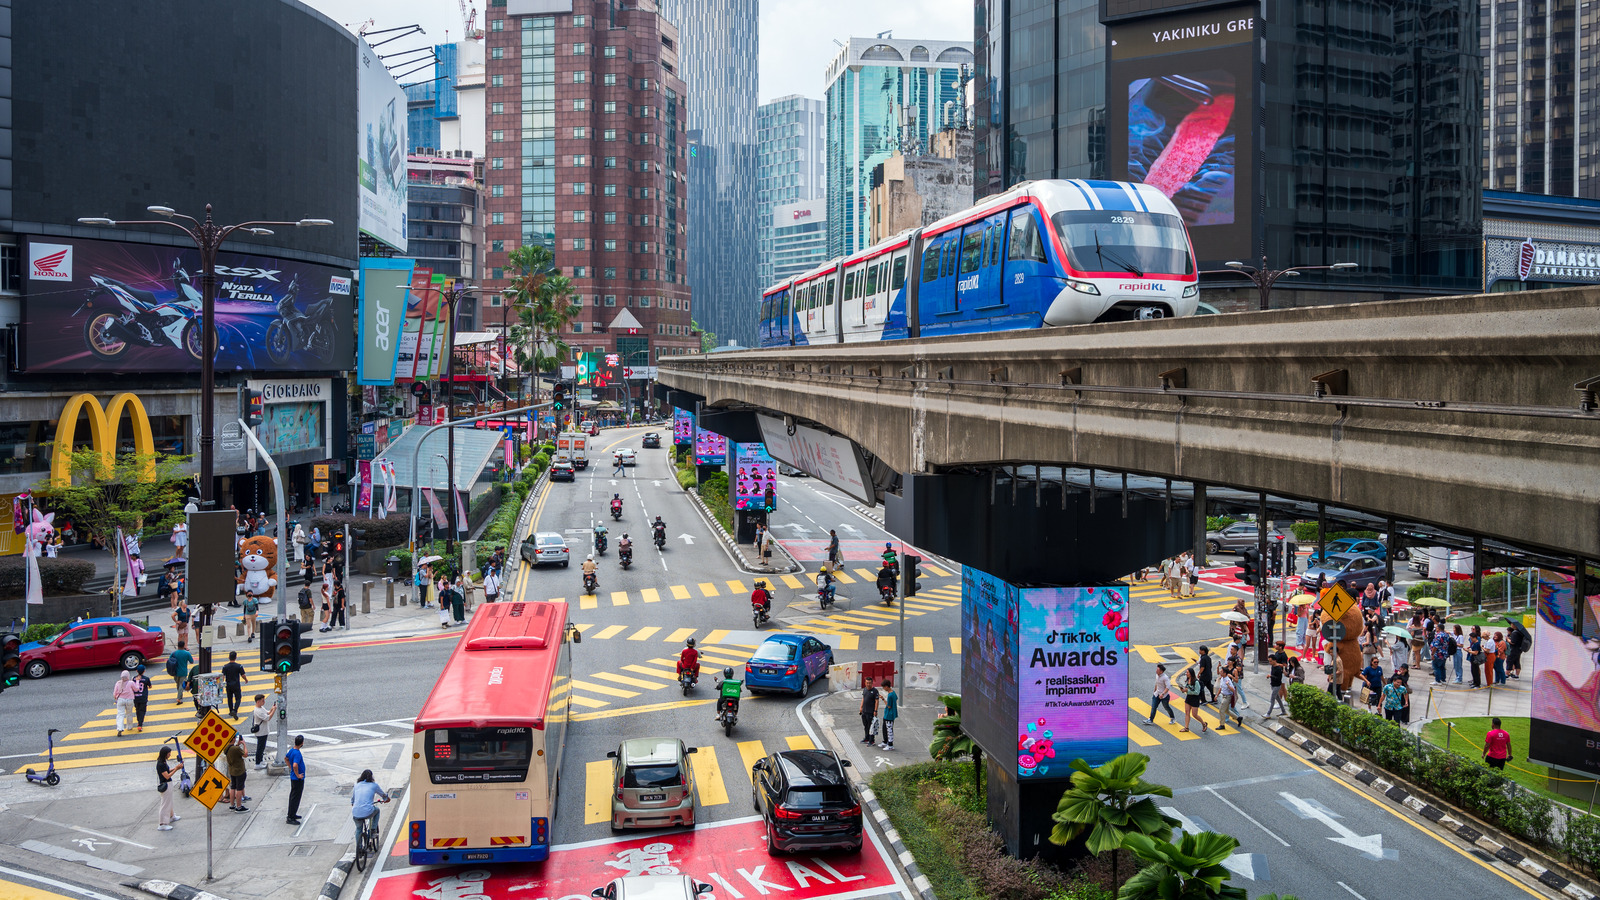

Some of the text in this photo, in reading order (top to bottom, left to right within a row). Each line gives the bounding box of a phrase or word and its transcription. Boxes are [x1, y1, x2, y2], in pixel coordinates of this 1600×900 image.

[1152, 23, 1221, 43] YAKINIKU
[1110, 216, 1135, 224] 2829
[1536, 249, 1600, 267] DAMASC
[33, 270, 69, 278] HONDA
[957, 274, 979, 294] rapidKL
[1118, 283, 1167, 292] rapidKL
[375, 300, 390, 351] acer
[263, 383, 320, 400] GIORDANO
[1060, 632, 1102, 643] TikTok
[1029, 646, 1118, 668] Awards
[1045, 674, 1105, 686] realisasikan
[1045, 685, 1097, 697] impianmu
[1044, 699, 1115, 708] #TikTokAwardsMY2024
